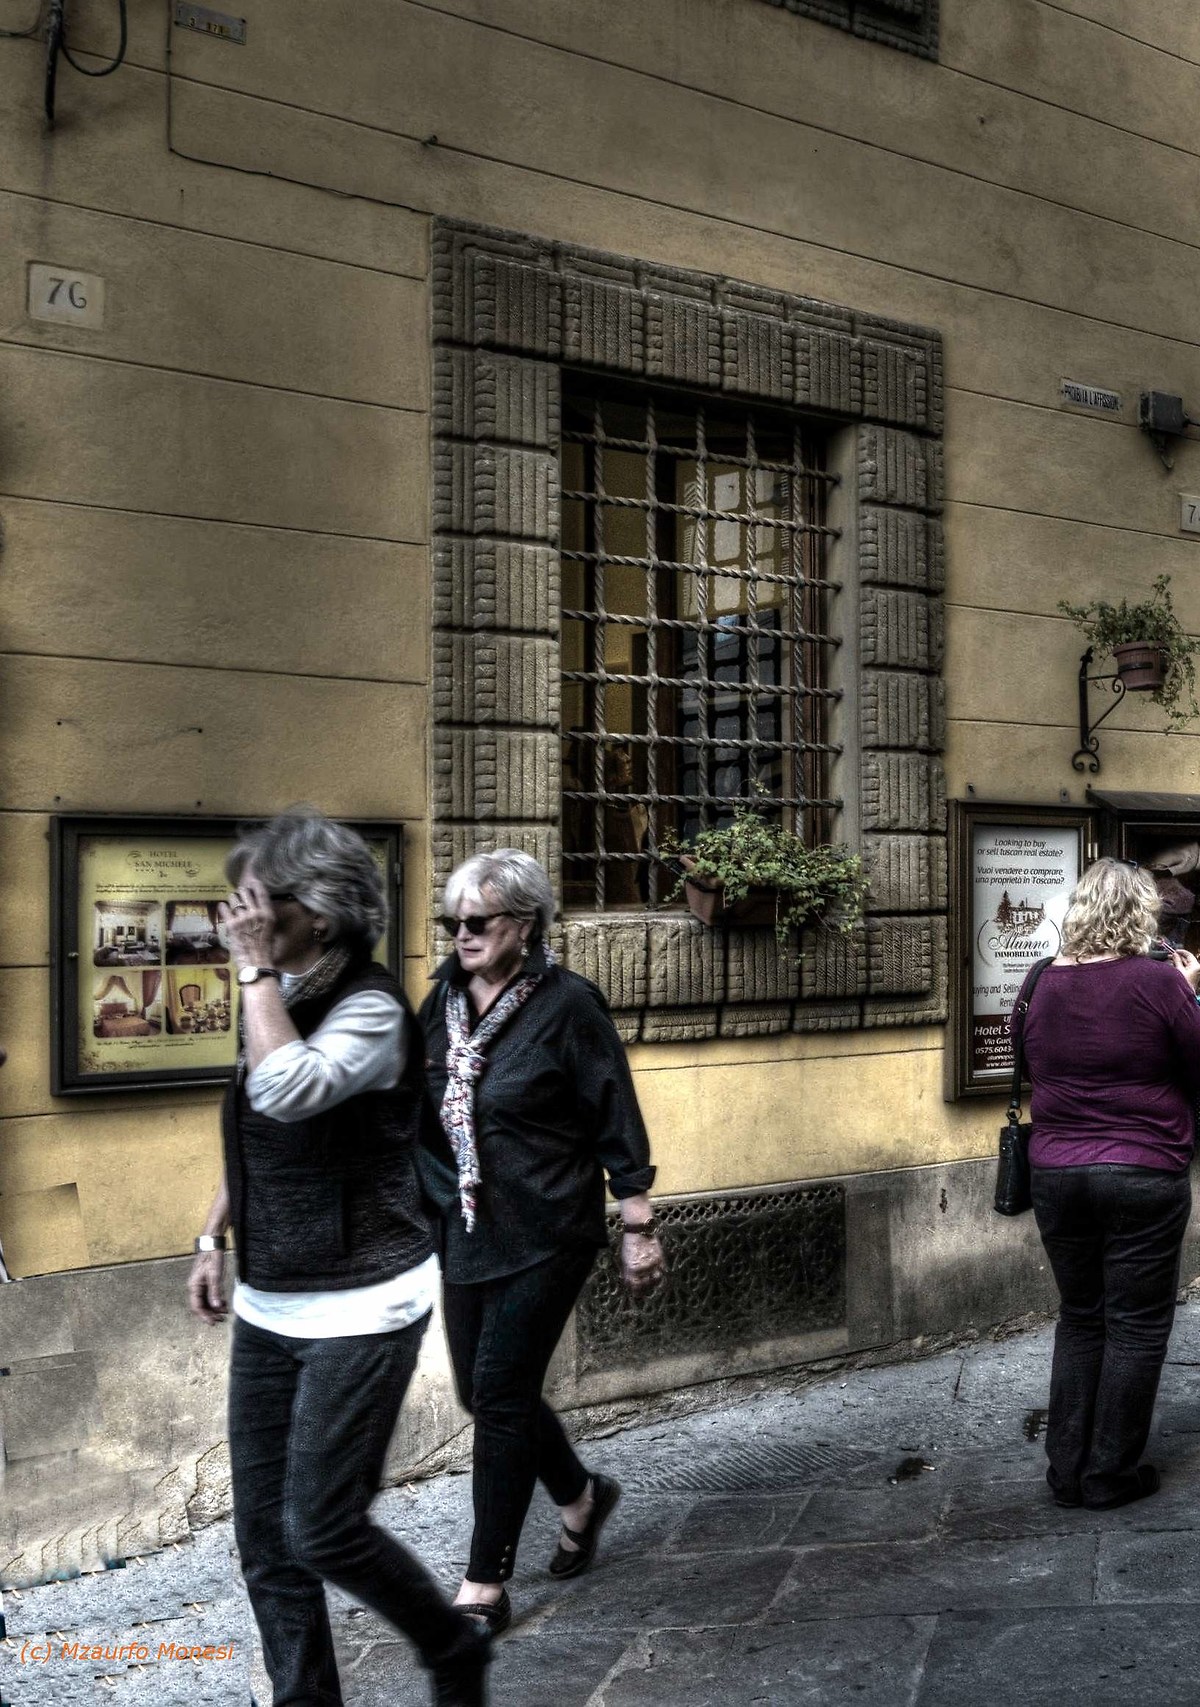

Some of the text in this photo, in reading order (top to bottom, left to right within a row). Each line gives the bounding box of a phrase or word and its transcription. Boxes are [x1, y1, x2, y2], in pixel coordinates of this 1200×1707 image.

[47, 276, 87, 309] 76
[994, 838, 1023, 849] Looking
[1033, 841, 1047, 850] buy
[1024, 849, 1038, 857] real
[1039, 849, 1064, 857] estate?
[977, 866, 994, 874] Vuoi
[995, 867, 1022, 875] vendere
[1030, 868, 1063, 877] comprare
[1032, 877, 1065, 885] Toscana?
[975, 1026, 1001, 1036] Hotel
